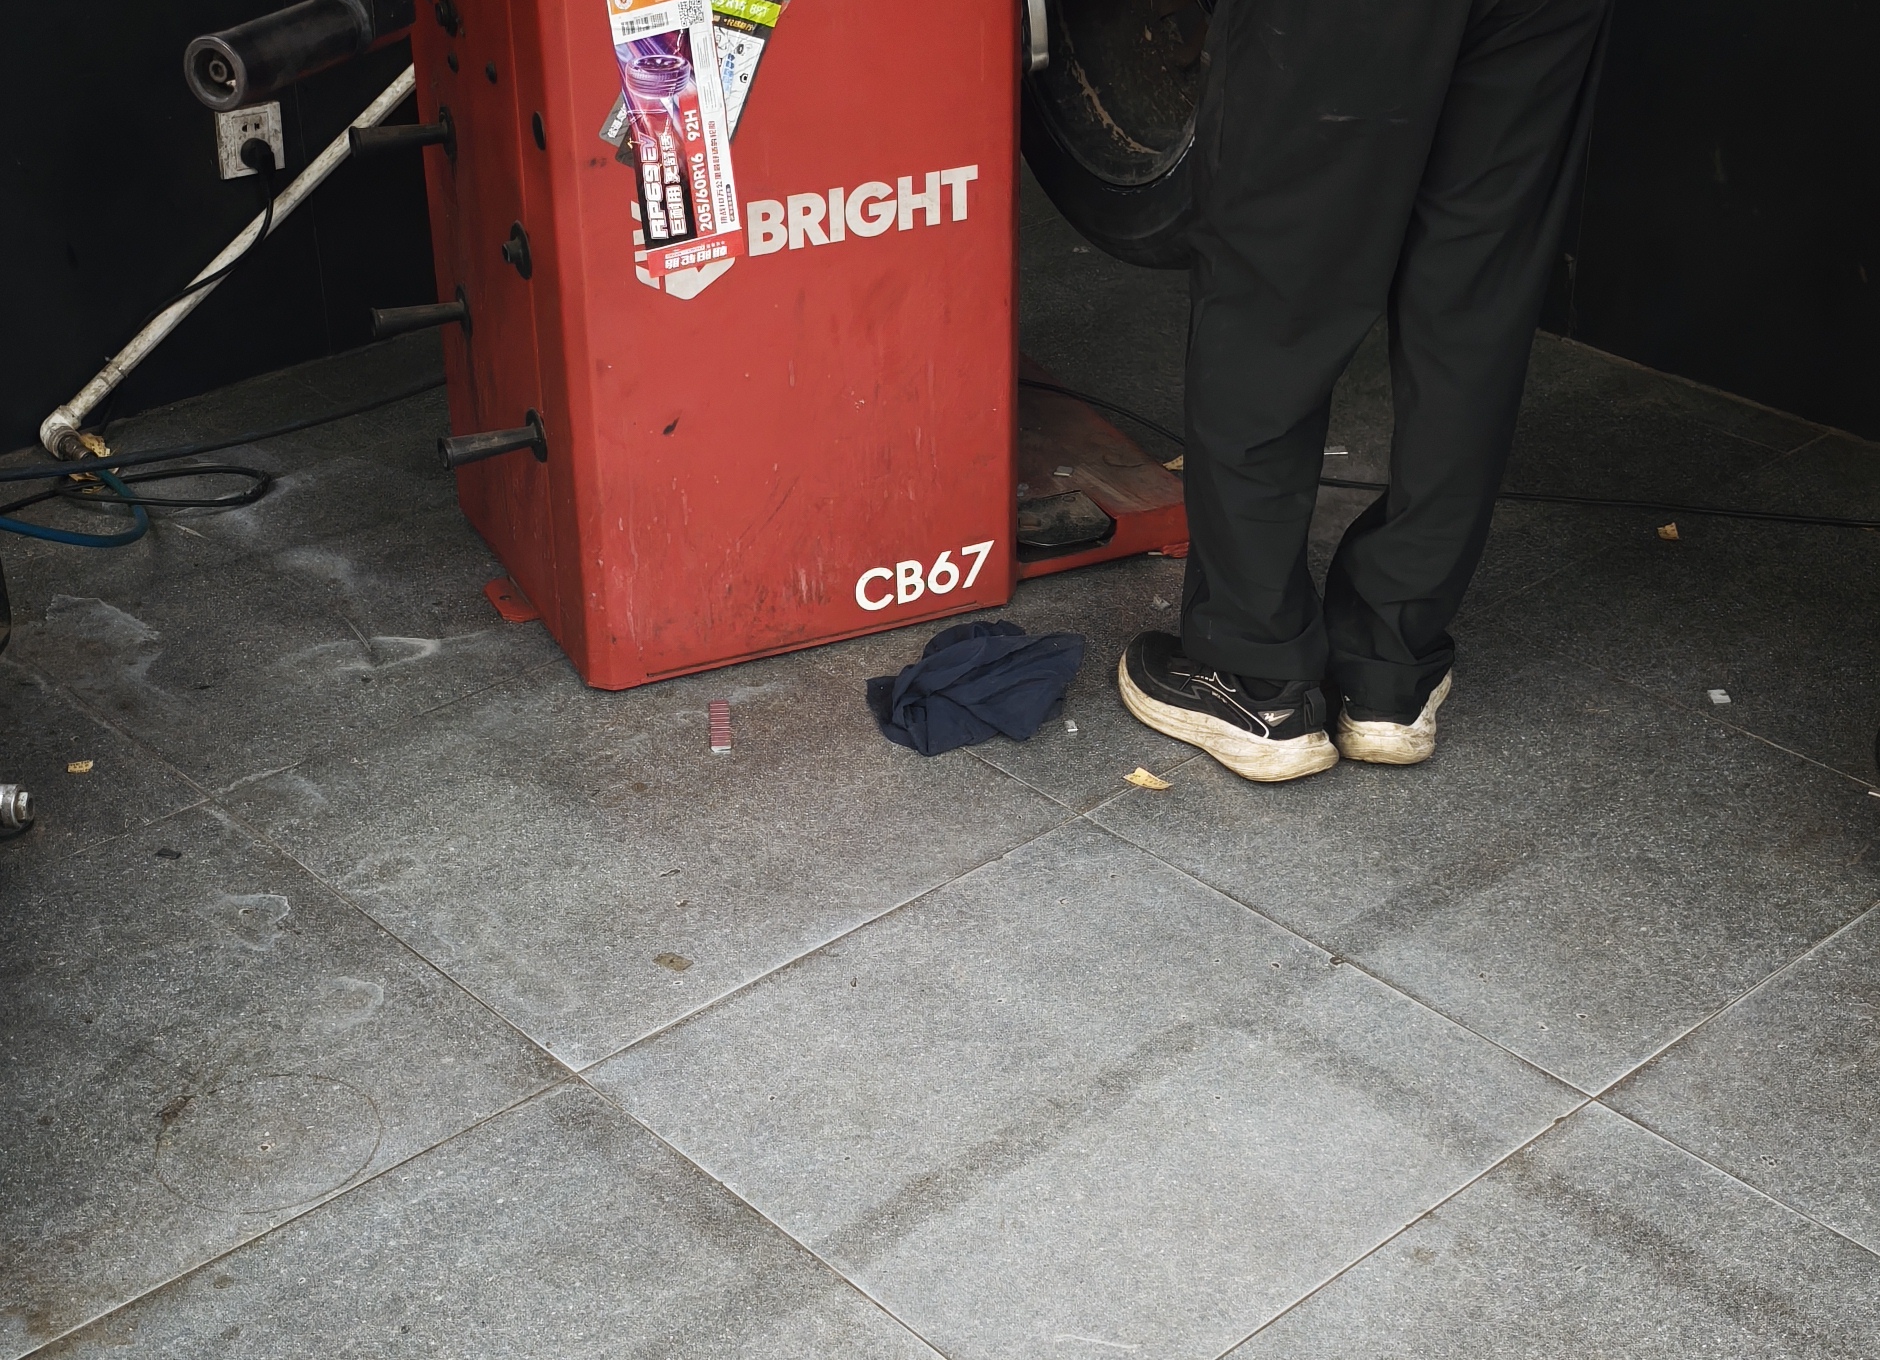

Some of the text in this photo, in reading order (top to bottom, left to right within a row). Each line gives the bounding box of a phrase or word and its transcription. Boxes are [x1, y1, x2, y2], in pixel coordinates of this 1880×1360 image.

[684, 109, 702, 142] 92H
[690, 152, 713, 232] 205/60R16
[746, 164, 979, 258] BRIGHT
[854, 540, 995, 611] CB67
